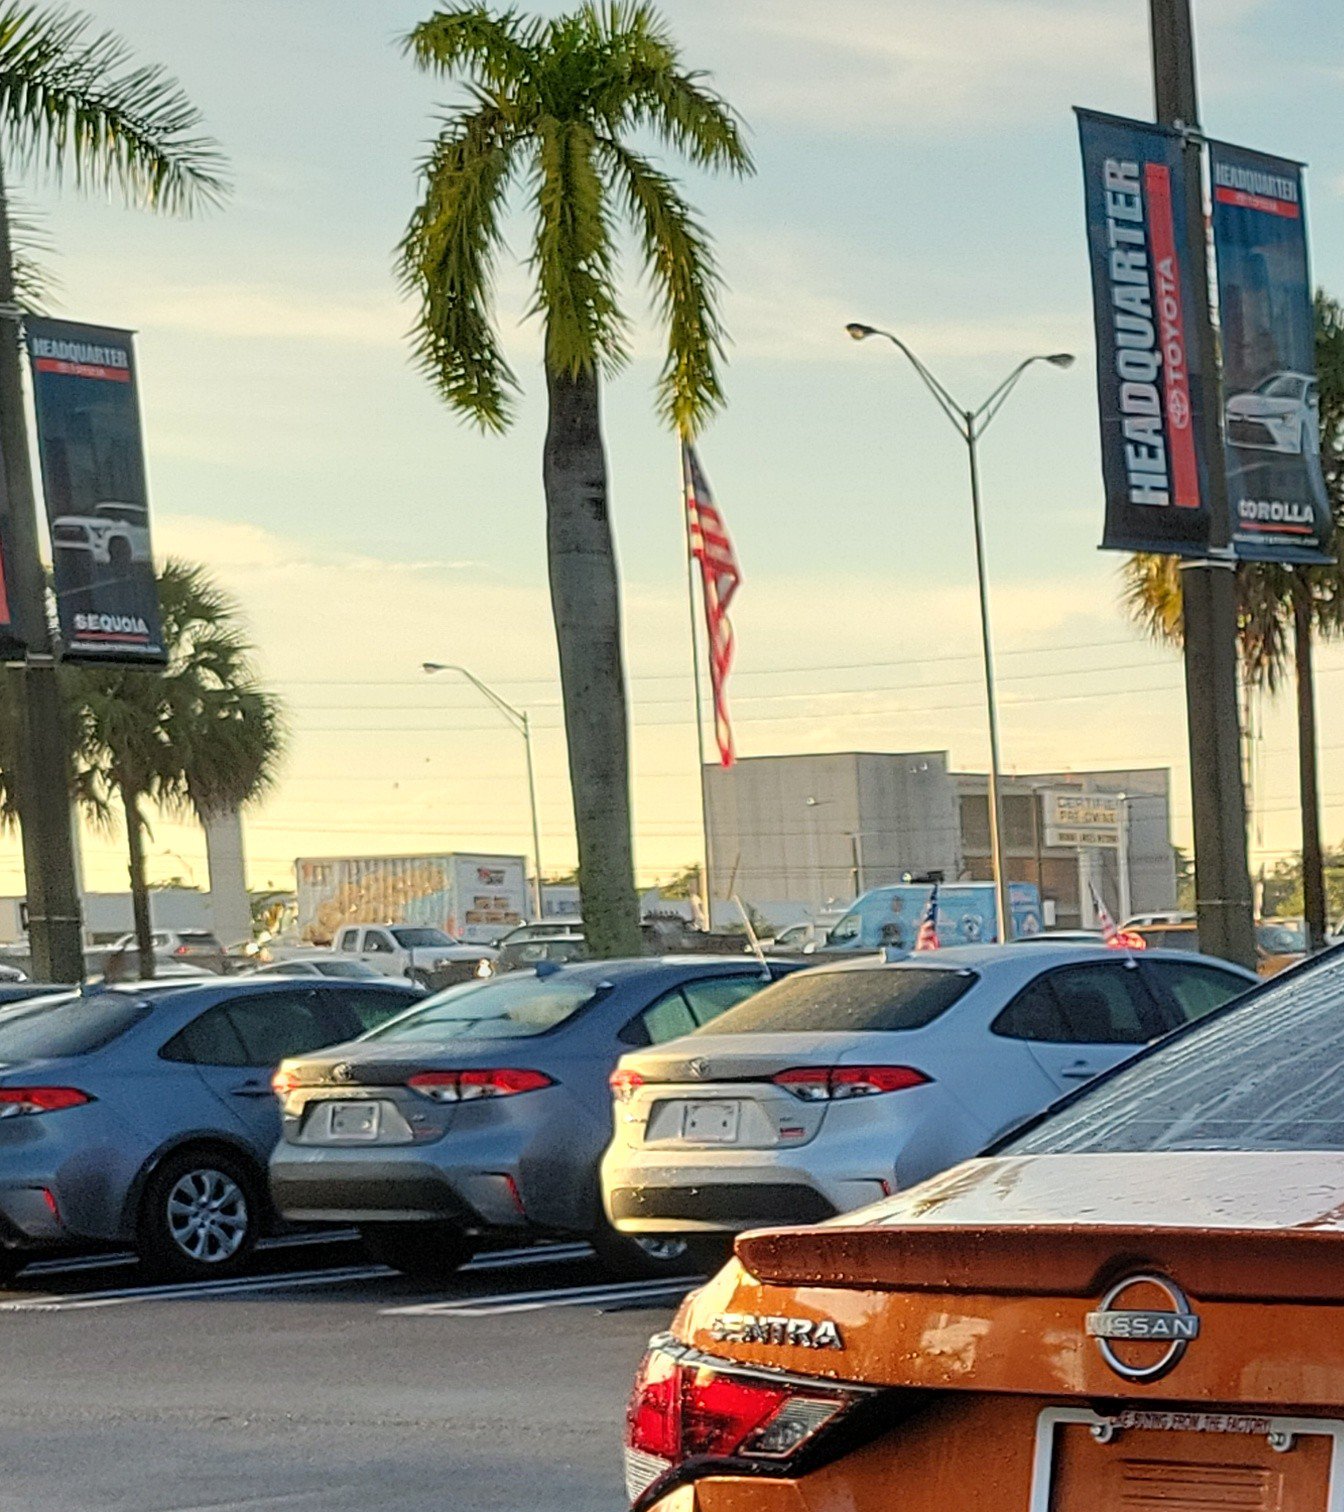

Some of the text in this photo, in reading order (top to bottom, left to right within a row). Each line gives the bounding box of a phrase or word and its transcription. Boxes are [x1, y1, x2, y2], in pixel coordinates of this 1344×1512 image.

[1215, 163, 1298, 202] HEADQUARTER
[1105, 159, 1170, 506] HEADQUARTER
[1157, 257, 1185, 386] TOYOTA
[33, 337, 128, 368] HEADQUARTER
[1238, 500, 1314, 523] COROLLA
[74, 612, 149, 634] SEQUOIA
[711, 1313, 847, 1350] SENTRA
[1090, 1316, 1193, 1336] NISSAN
